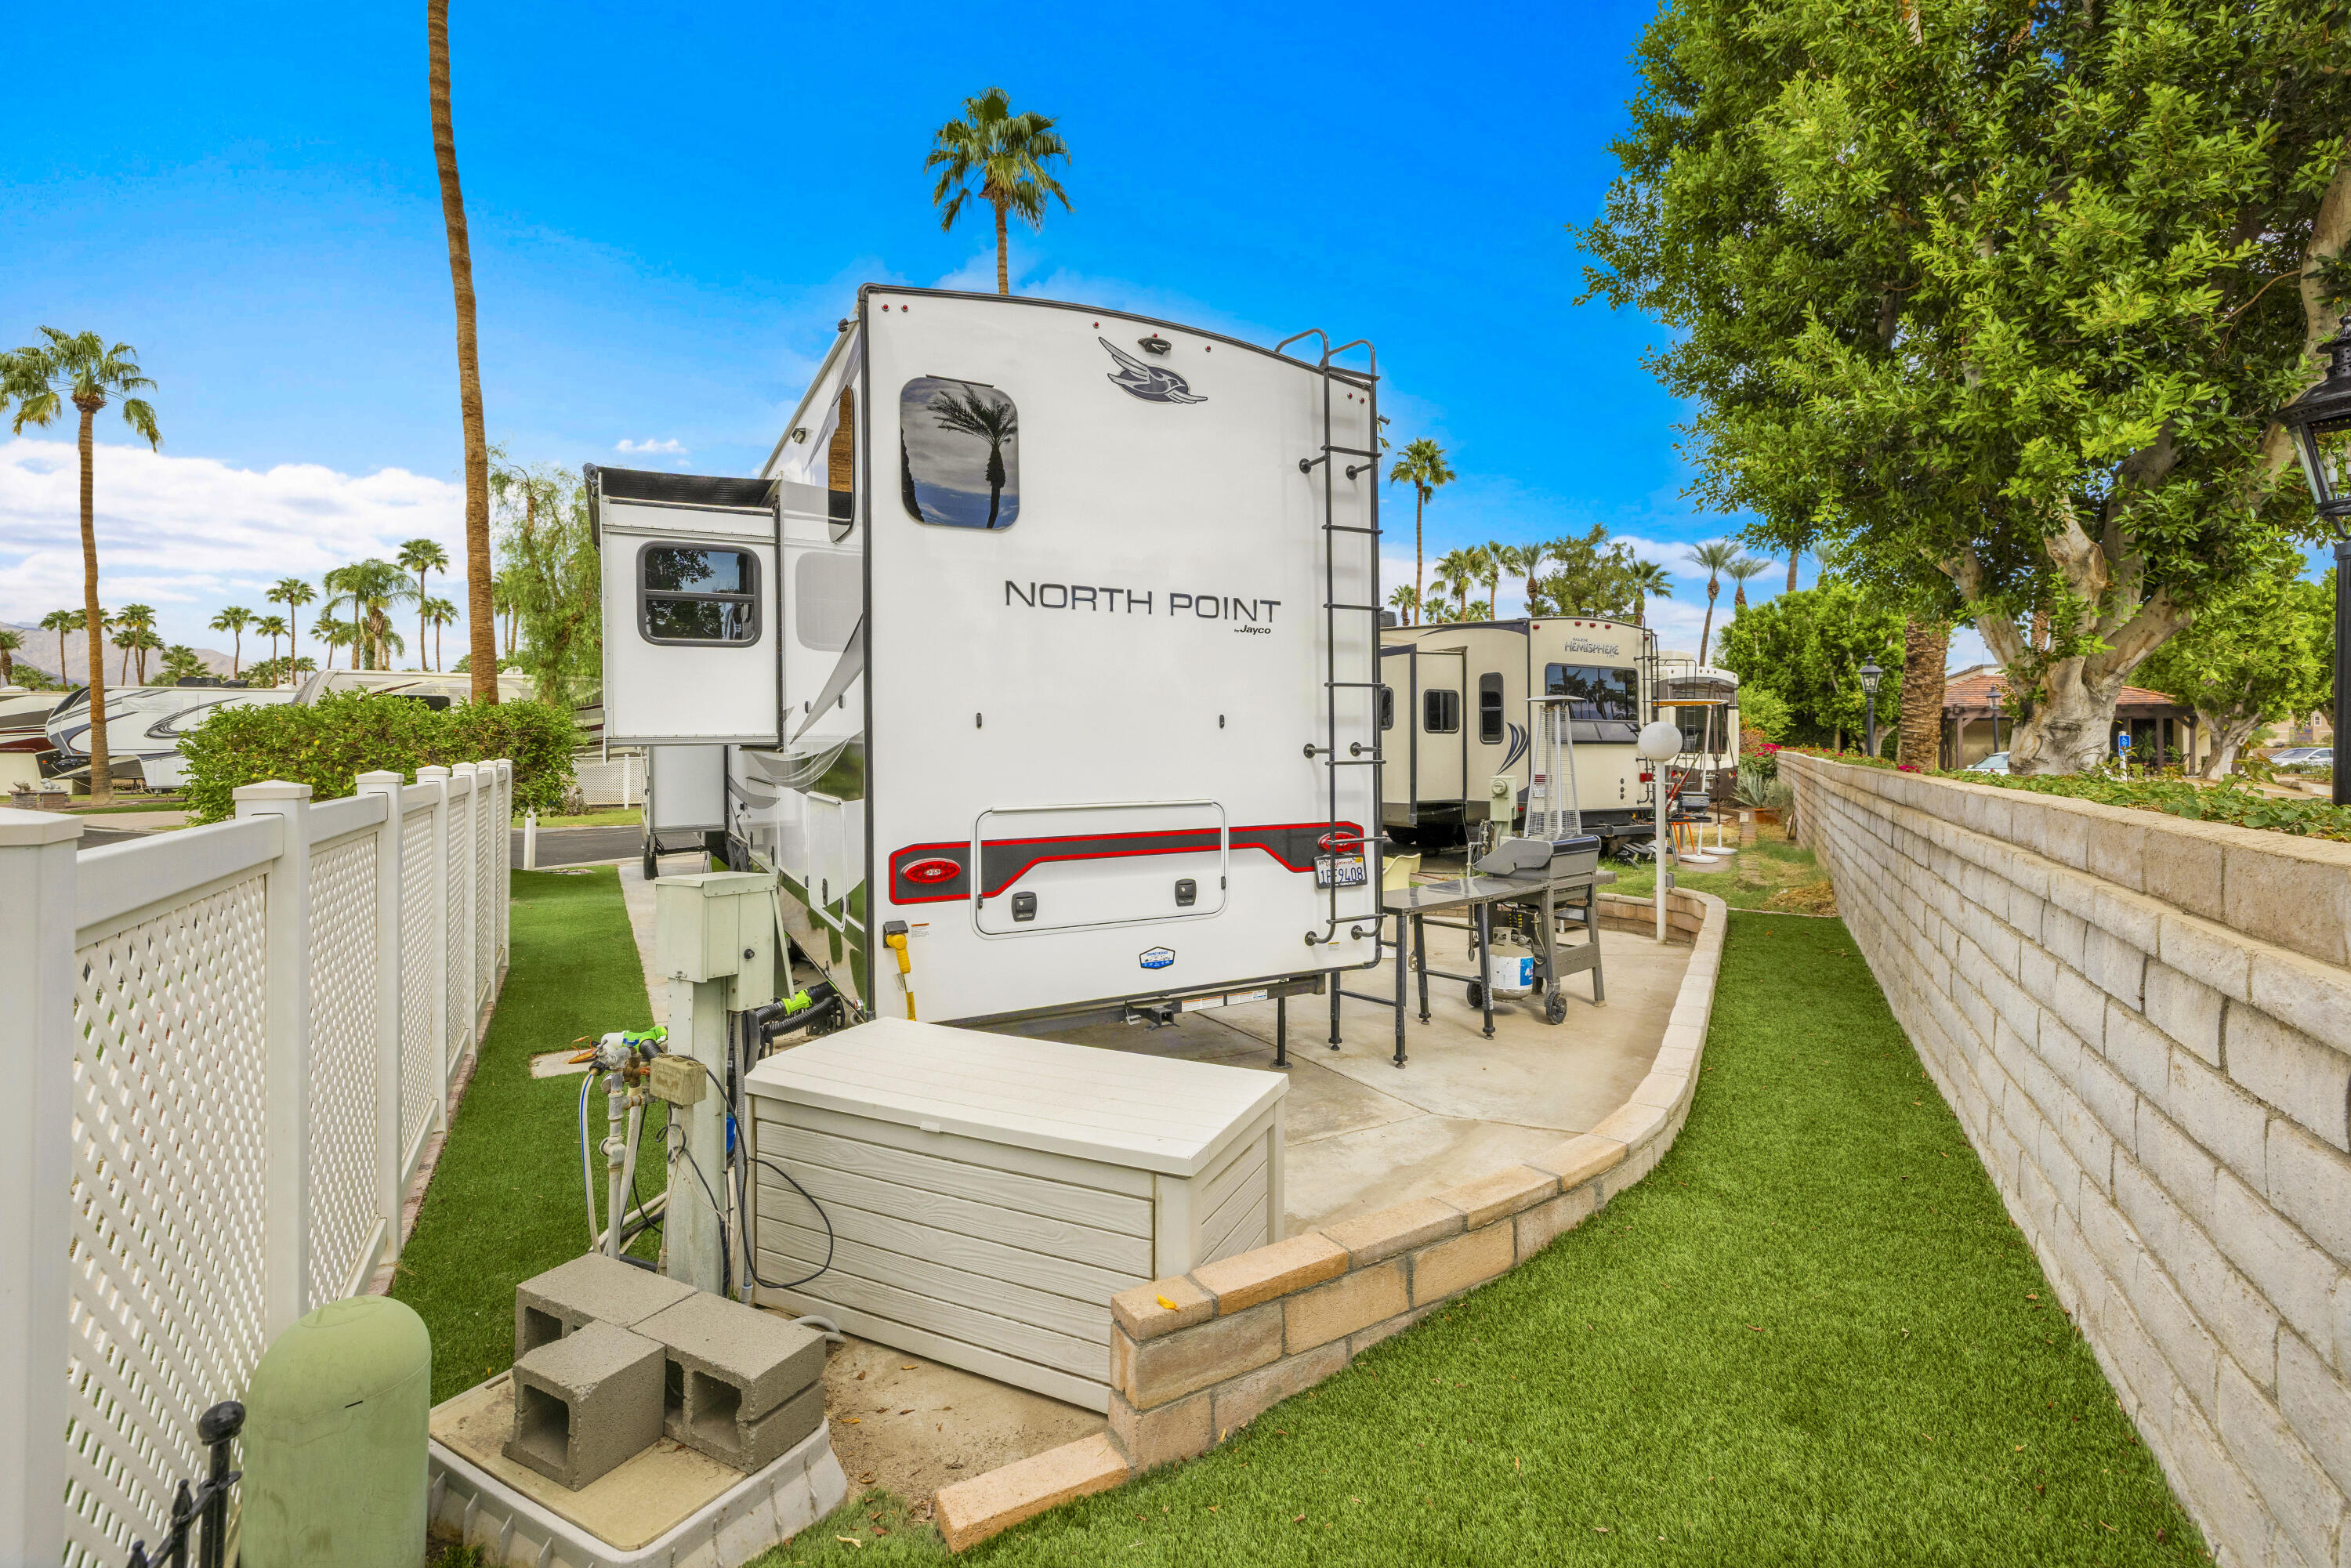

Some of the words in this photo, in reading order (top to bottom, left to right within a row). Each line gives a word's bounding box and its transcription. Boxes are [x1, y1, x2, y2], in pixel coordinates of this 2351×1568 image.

[1005, 580, 1153, 615] NORTH
[1169, 592, 1281, 623] POINT
[1240, 625, 1271, 635] Jayco
[1564, 640, 1619, 655] HEMISPHERE
[1325, 858, 1354, 867] Cfornia
[1320, 867, 1364, 884] 1P9408
